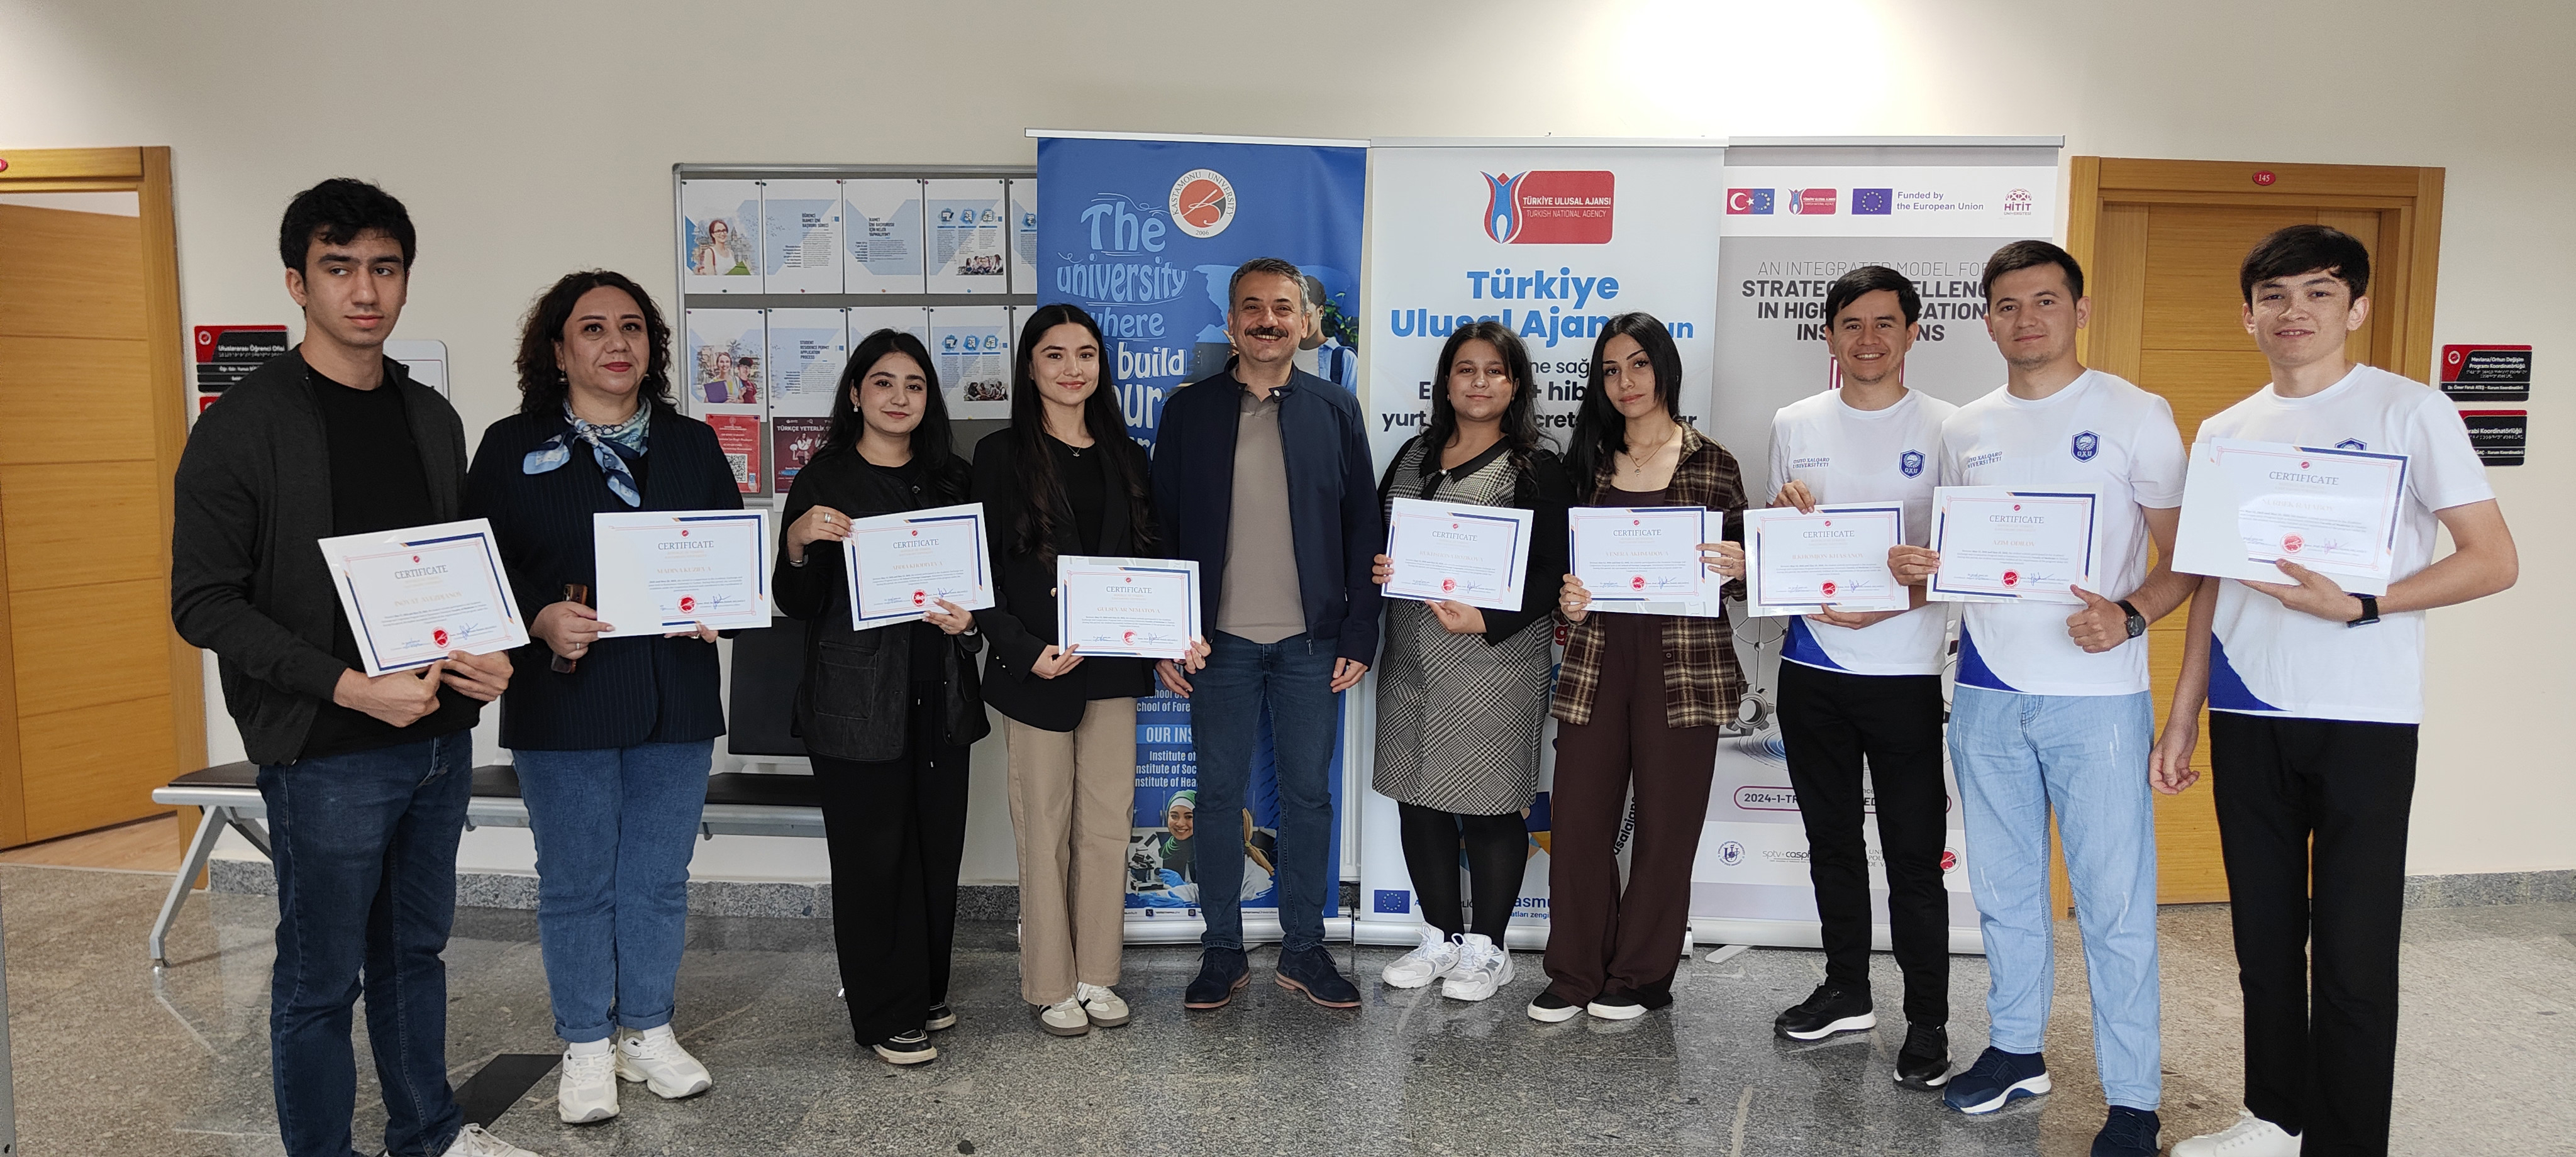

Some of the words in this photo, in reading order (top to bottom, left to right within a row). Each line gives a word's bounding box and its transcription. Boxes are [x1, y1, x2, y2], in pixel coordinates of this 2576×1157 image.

[1172, 172, 1201, 215] KASTAMONU
[1208, 172, 1234, 216] UNIVERSITY
[1933, 191, 1944, 200] by
[1523, 196, 1553, 205] TÜRKİYE
[1913, 202, 1955, 211] European
[2004, 201, 2031, 211] HİTİT
[1080, 201, 1167, 252] The
[1758, 262, 1780, 276] AN
[1786, 262, 1890, 276] INTEGR
[1897, 262, 1953, 277] MODEL
[1057, 253, 1189, 301] university
[1467, 267, 1619, 309] Türkiye
[1741, 280, 1838, 297] STRATE
[1758, 302, 1779, 319] IN
[1784, 302, 1826, 319] HIG
[1916, 302, 1987, 320] CATION
[249, 344, 271, 352] Öğrenci
[1118, 341, 1187, 380] build
[1382, 412, 1426, 431] yurt
[2269, 471, 2340, 485] CERTIFICATE
[1989, 515, 2045, 524] CERTIFICATE
[1432, 531, 1477, 541] CERTIFICATE
[1803, 530, 1855, 538] CERTIFICATE
[658, 541, 714, 550] CERTIFICATE
[893, 538, 940, 548] CERTIFICATE
[394, 565, 448, 579] CERTIFICATE
[1137, 702, 1160, 712] chool
[1162, 702, 1171, 712] of
[1172, 702, 1191, 712] Fore
[1146, 727, 1171, 743] OUR
[1150, 751, 1185, 761] Institute
[1136, 764, 1170, 774] nstitute
[1171, 764, 1180, 774] of
[1182, 764, 1197, 774] Soc
[1135, 777, 1169, 787] nstitute
[1170, 777, 1179, 787] of
[1181, 777, 1197, 787] Hea
